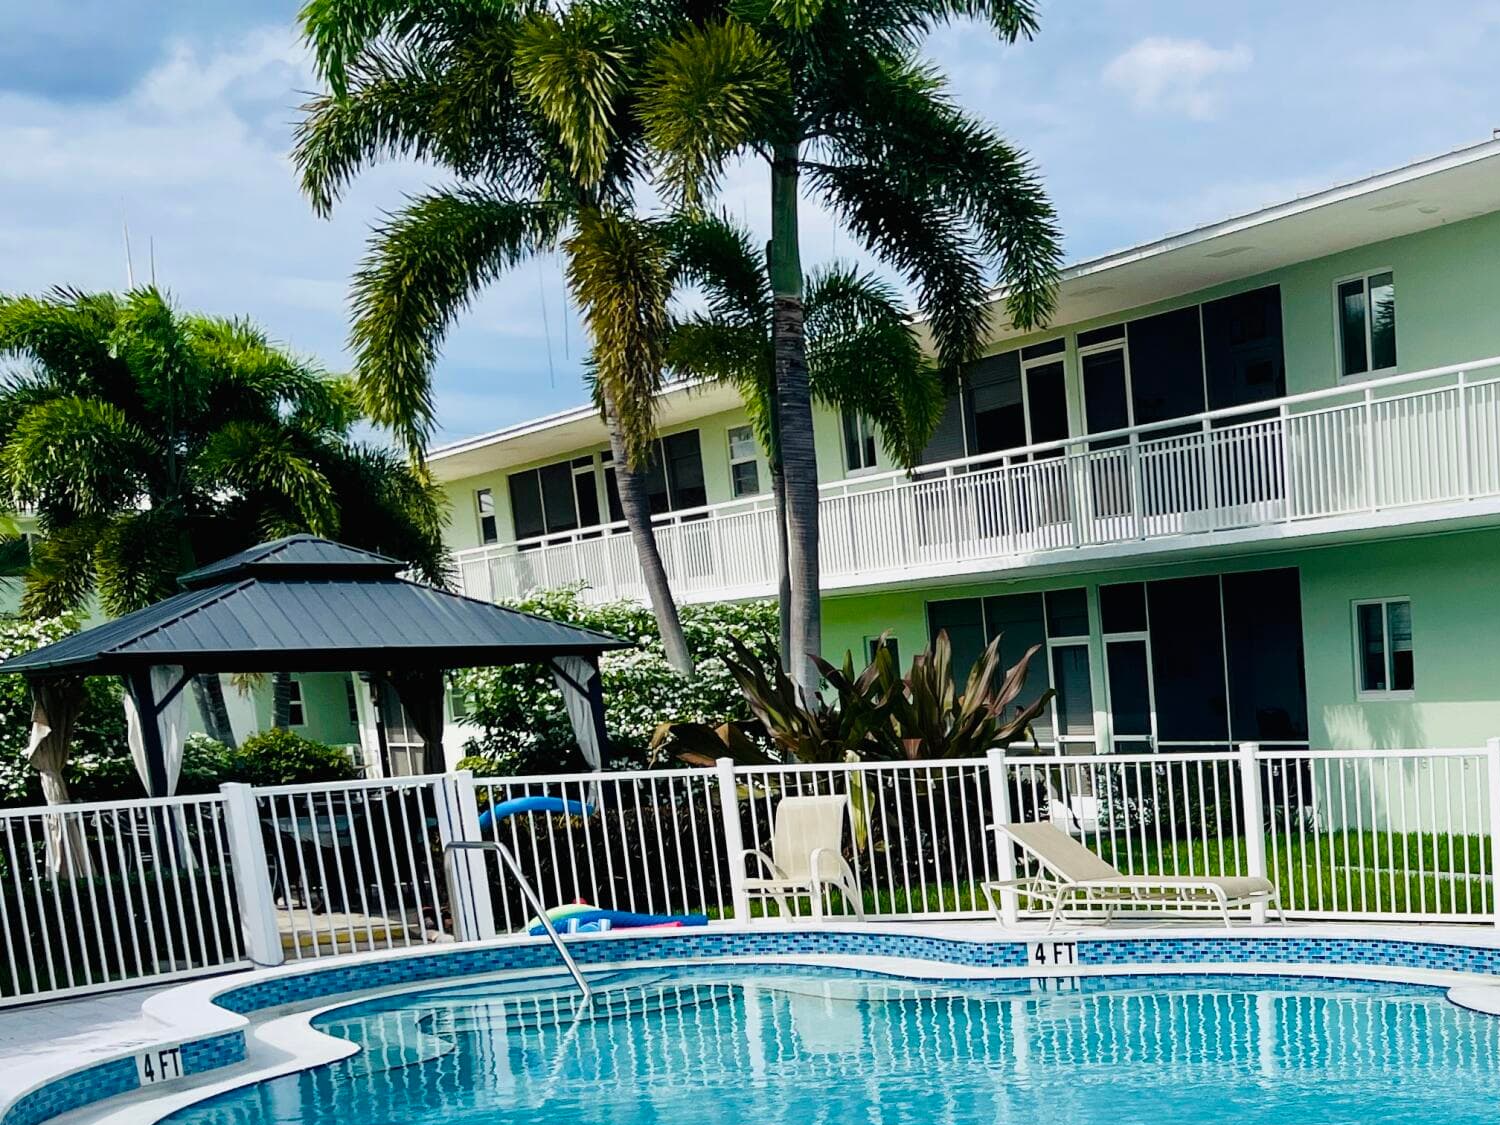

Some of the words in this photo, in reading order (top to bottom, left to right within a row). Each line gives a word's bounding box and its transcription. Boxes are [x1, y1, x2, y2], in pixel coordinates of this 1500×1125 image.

[1035, 942, 1046, 965] 4
[1053, 942, 1076, 965] FT
[144, 1053, 155, 1082] 4
[158, 1048, 180, 1080] FT
